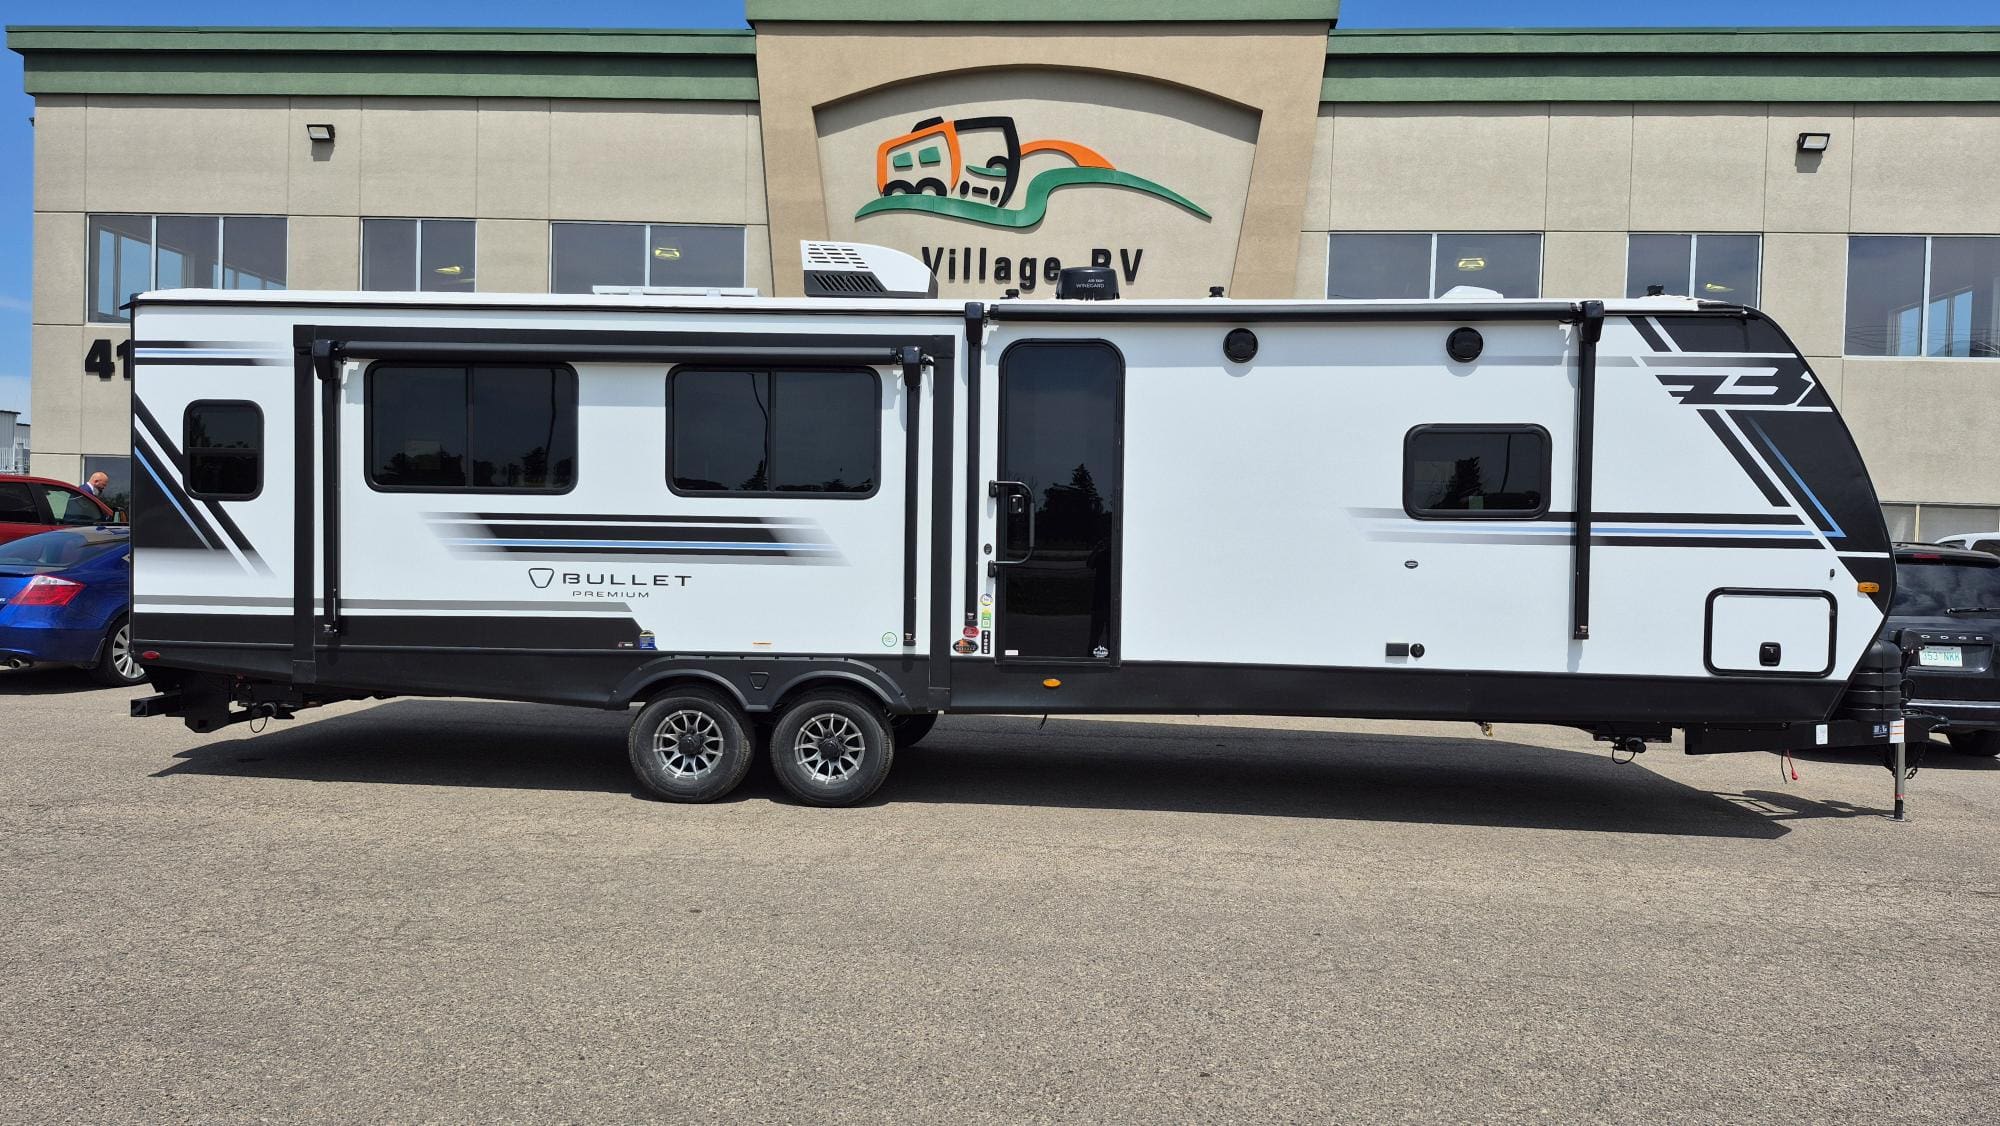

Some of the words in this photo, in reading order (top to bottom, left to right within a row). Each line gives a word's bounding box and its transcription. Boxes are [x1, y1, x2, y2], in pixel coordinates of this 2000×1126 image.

[921, 247, 1062, 289] Village
[562, 573, 692, 587] BULLET
[572, 590, 649, 598] PREMIUM
